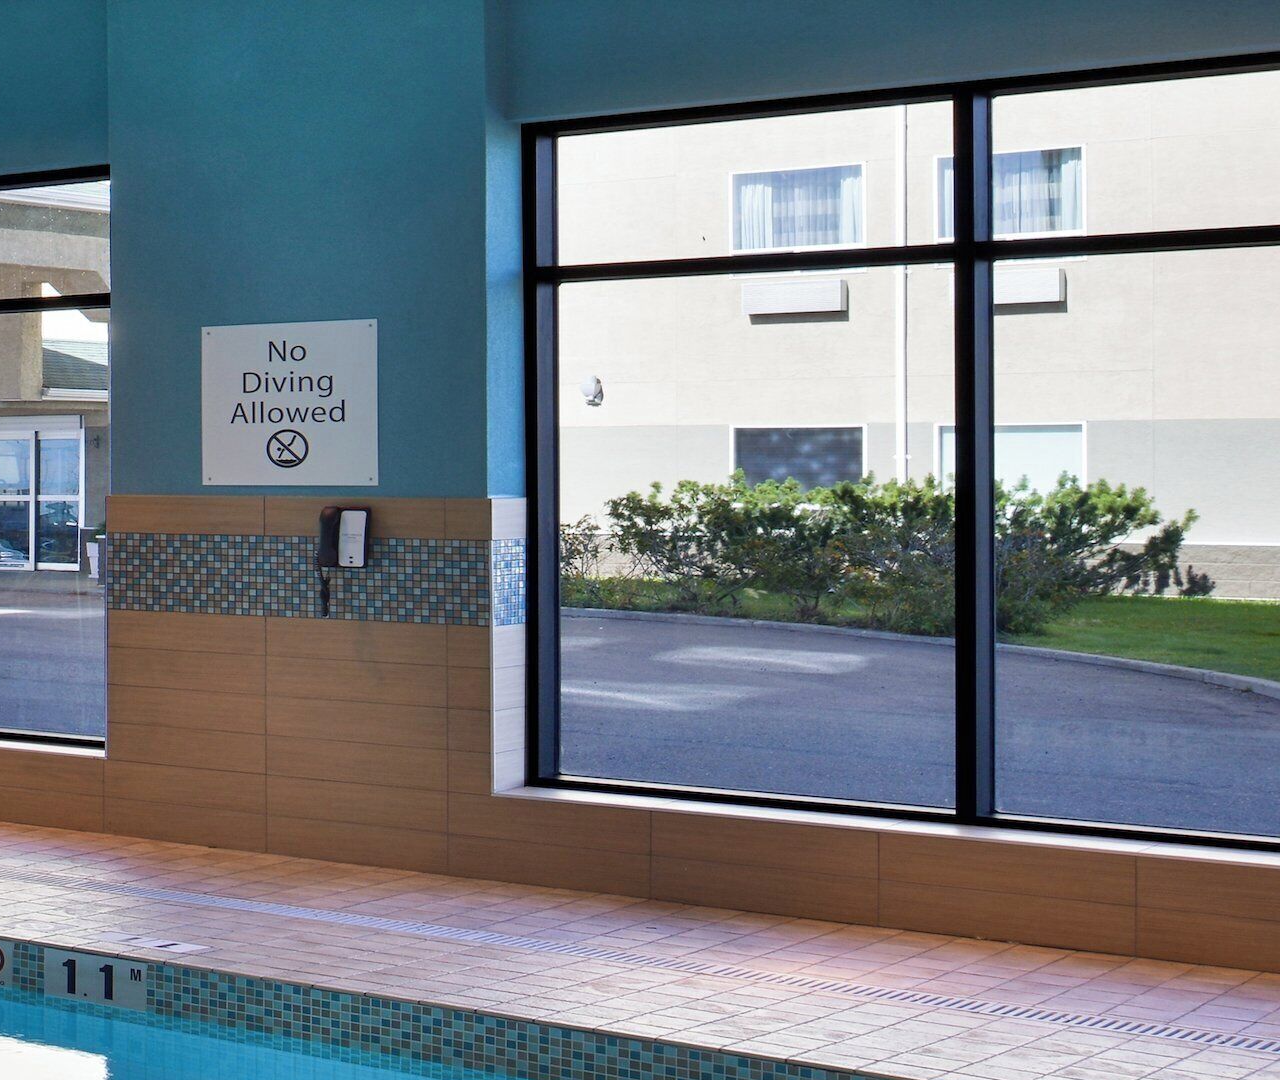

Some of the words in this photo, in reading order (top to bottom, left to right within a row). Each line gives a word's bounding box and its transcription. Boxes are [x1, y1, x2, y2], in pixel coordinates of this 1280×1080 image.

[268, 340, 307, 362] No
[243, 371, 333, 398] Diving
[230, 400, 346, 424] Allowed
